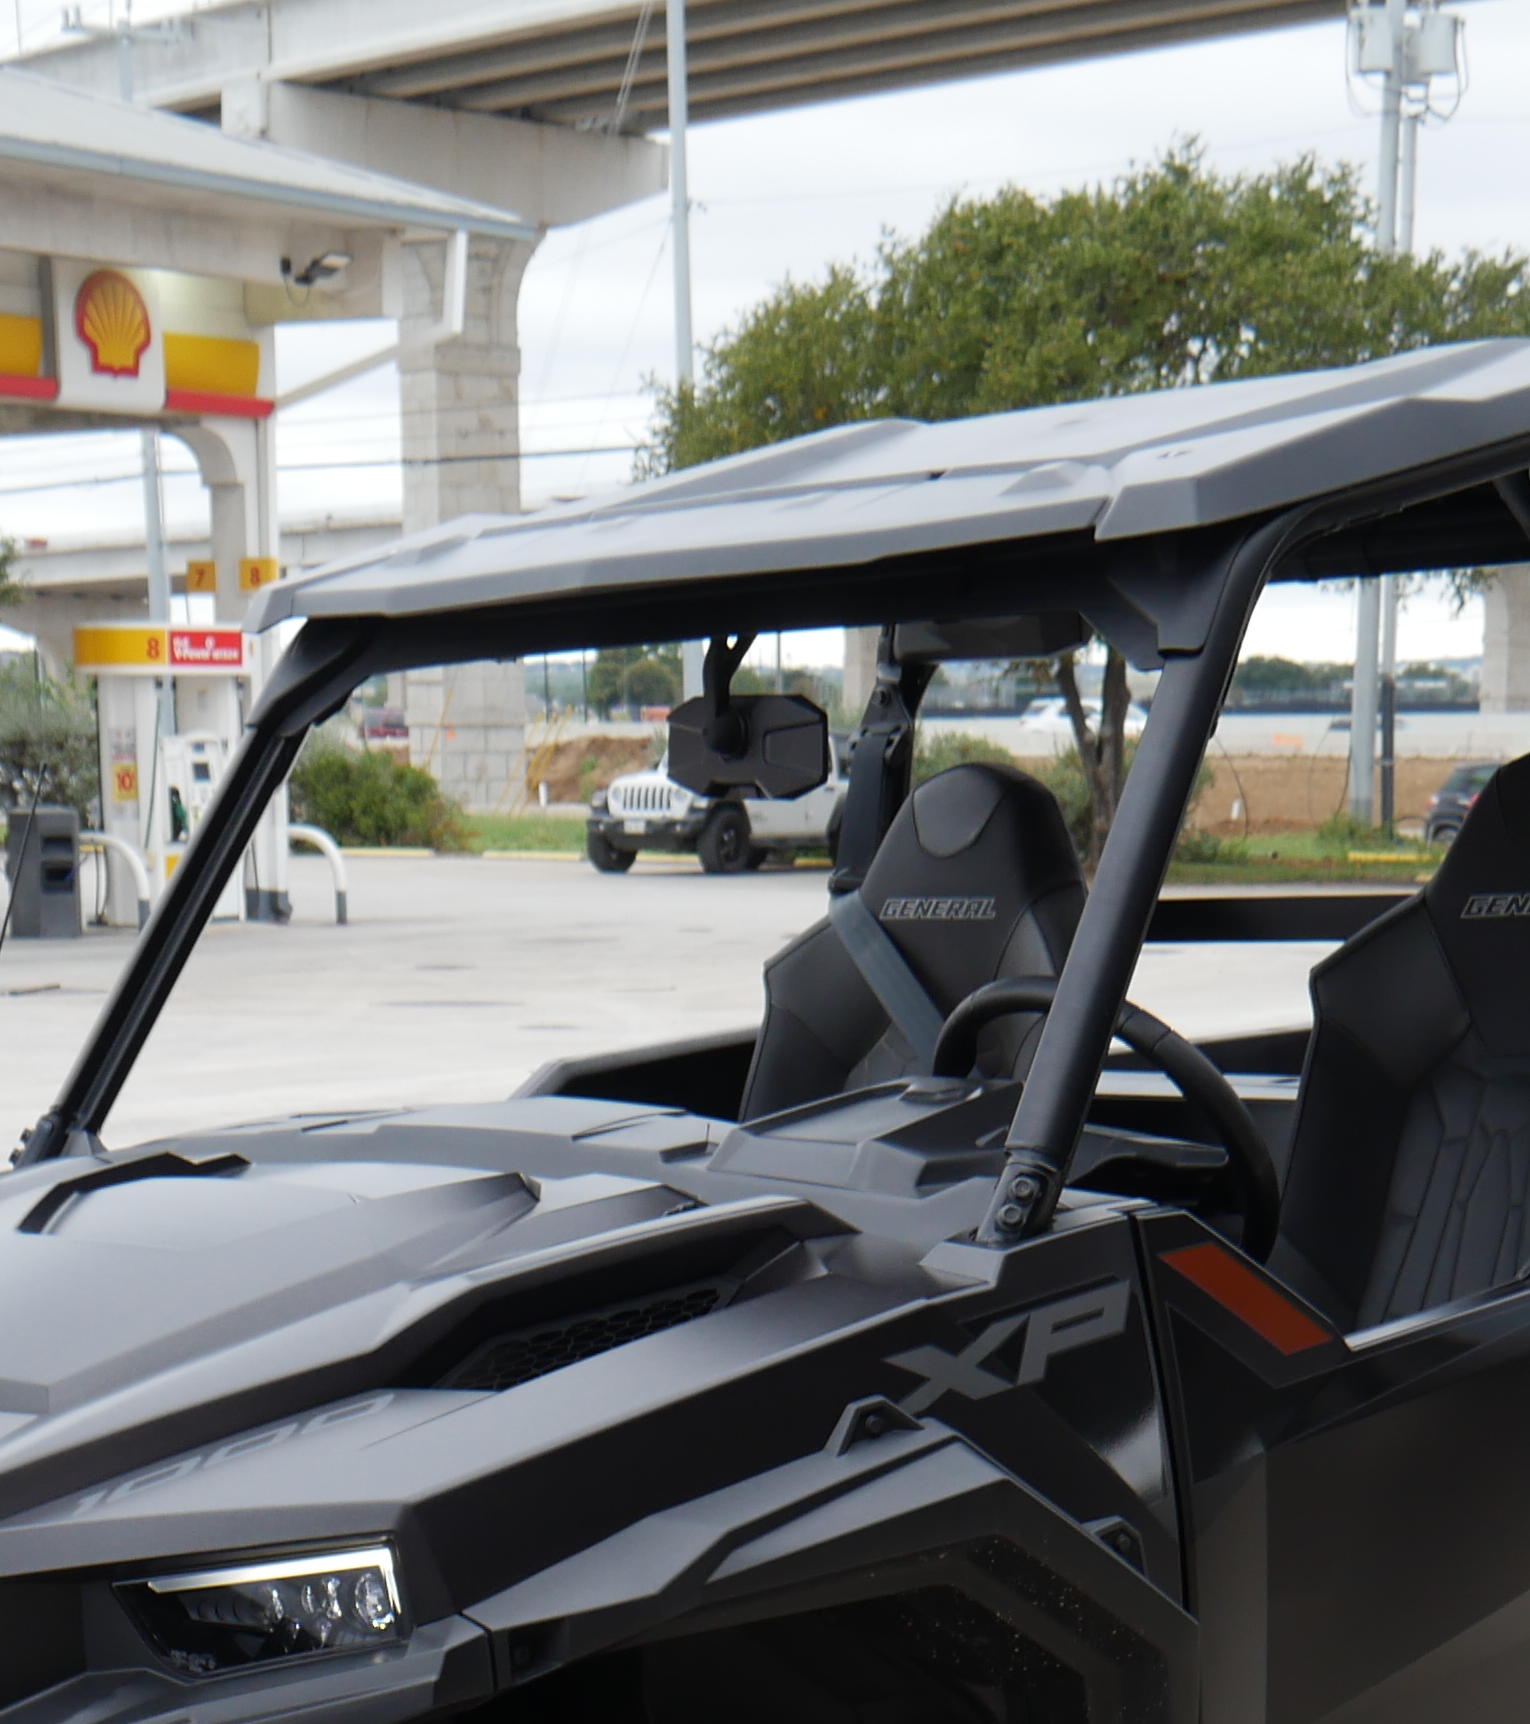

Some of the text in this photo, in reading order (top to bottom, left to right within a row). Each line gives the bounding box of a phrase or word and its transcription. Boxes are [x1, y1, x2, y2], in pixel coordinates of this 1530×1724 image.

[195, 567, 207, 590] 7
[248, 566, 261, 588] 8
[146, 636, 161, 661] 8
[880, 899, 995, 919] GENERAL
[881, 1277, 1132, 1415] XP
